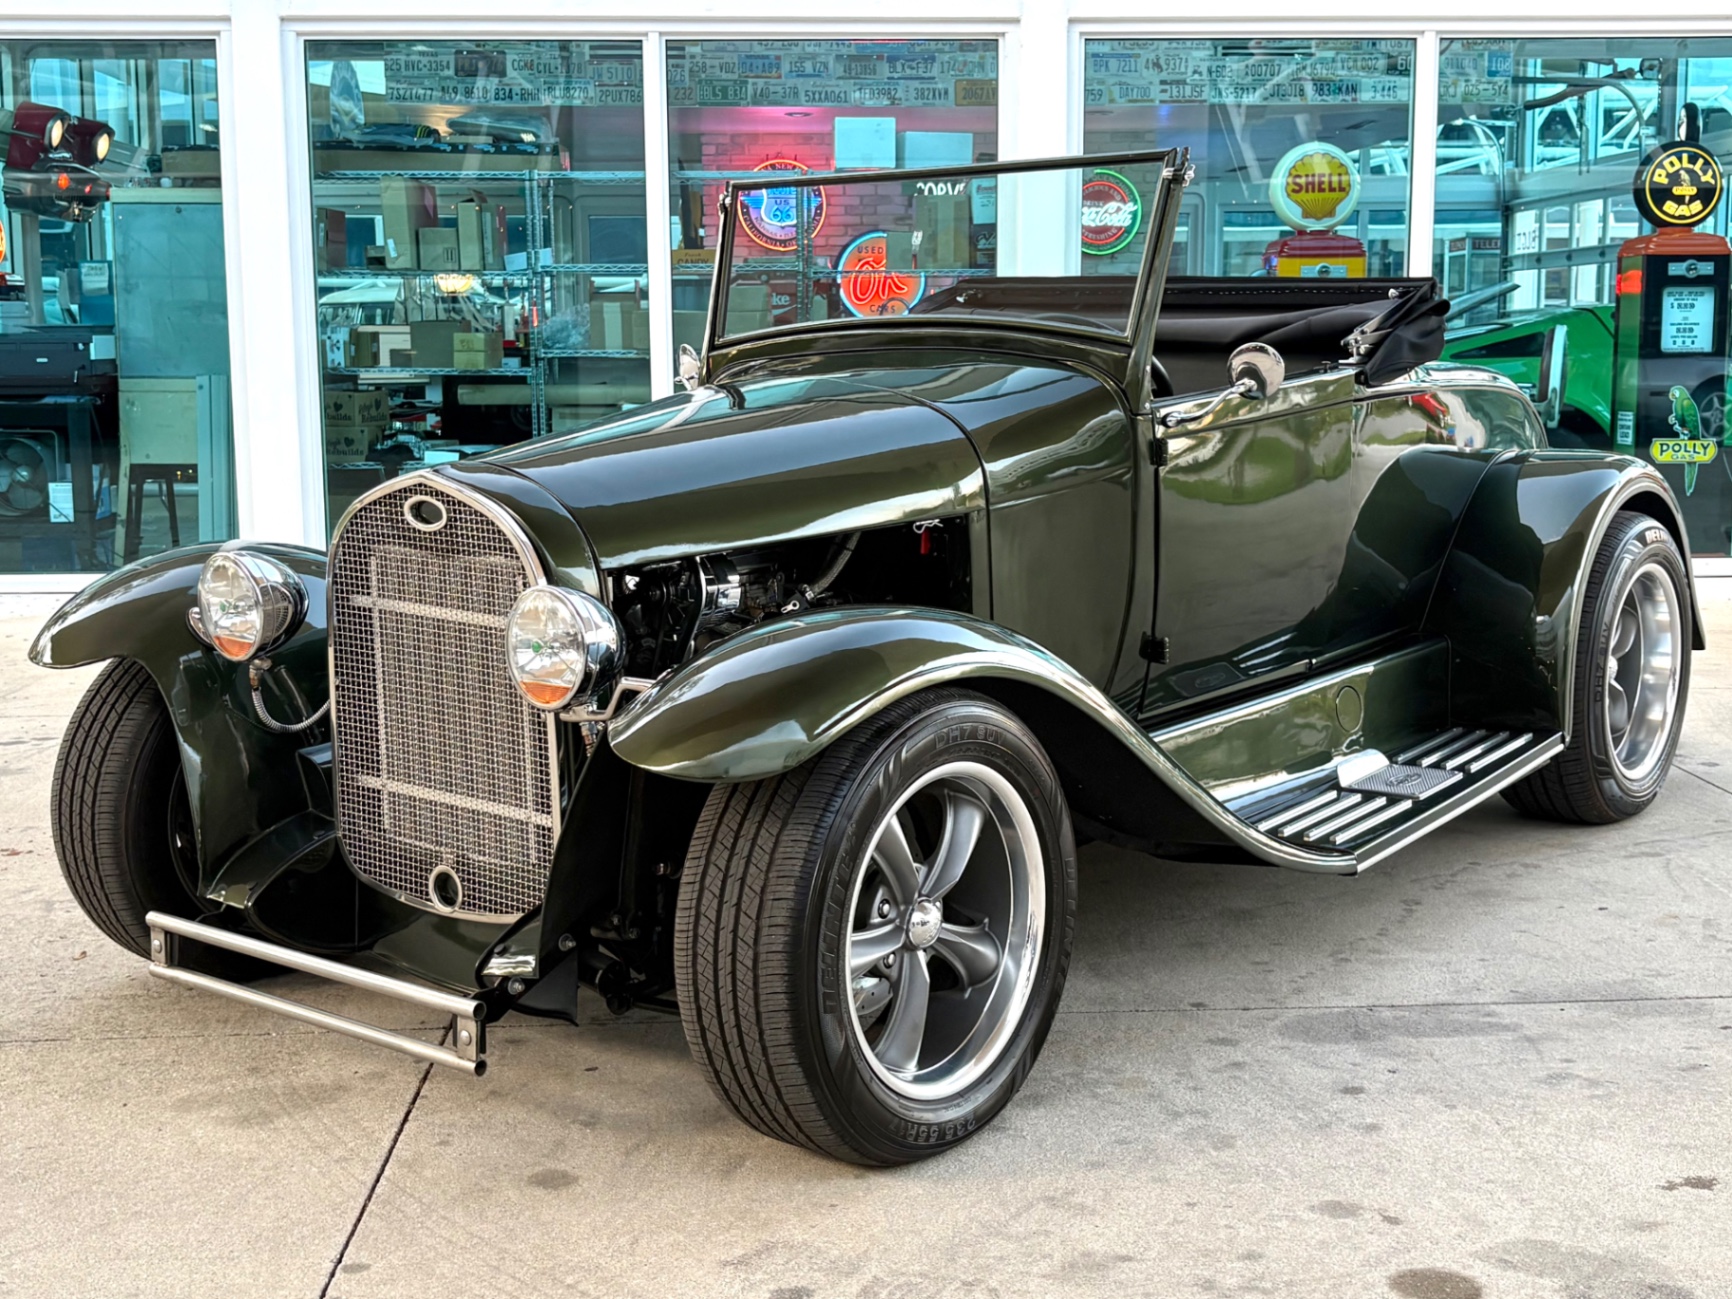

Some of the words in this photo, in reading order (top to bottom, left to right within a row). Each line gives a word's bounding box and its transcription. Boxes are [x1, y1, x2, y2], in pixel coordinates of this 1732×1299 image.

[1652, 152, 1716, 186] POLLY
[1291, 173, 1346, 194] SHELL
[770, 205, 794, 222] 66
[1662, 199, 1704, 218] GAS
[857, 240, 884, 255] USED
[1659, 442, 1711, 457] POLLY
[934, 724, 972, 750] DH7
